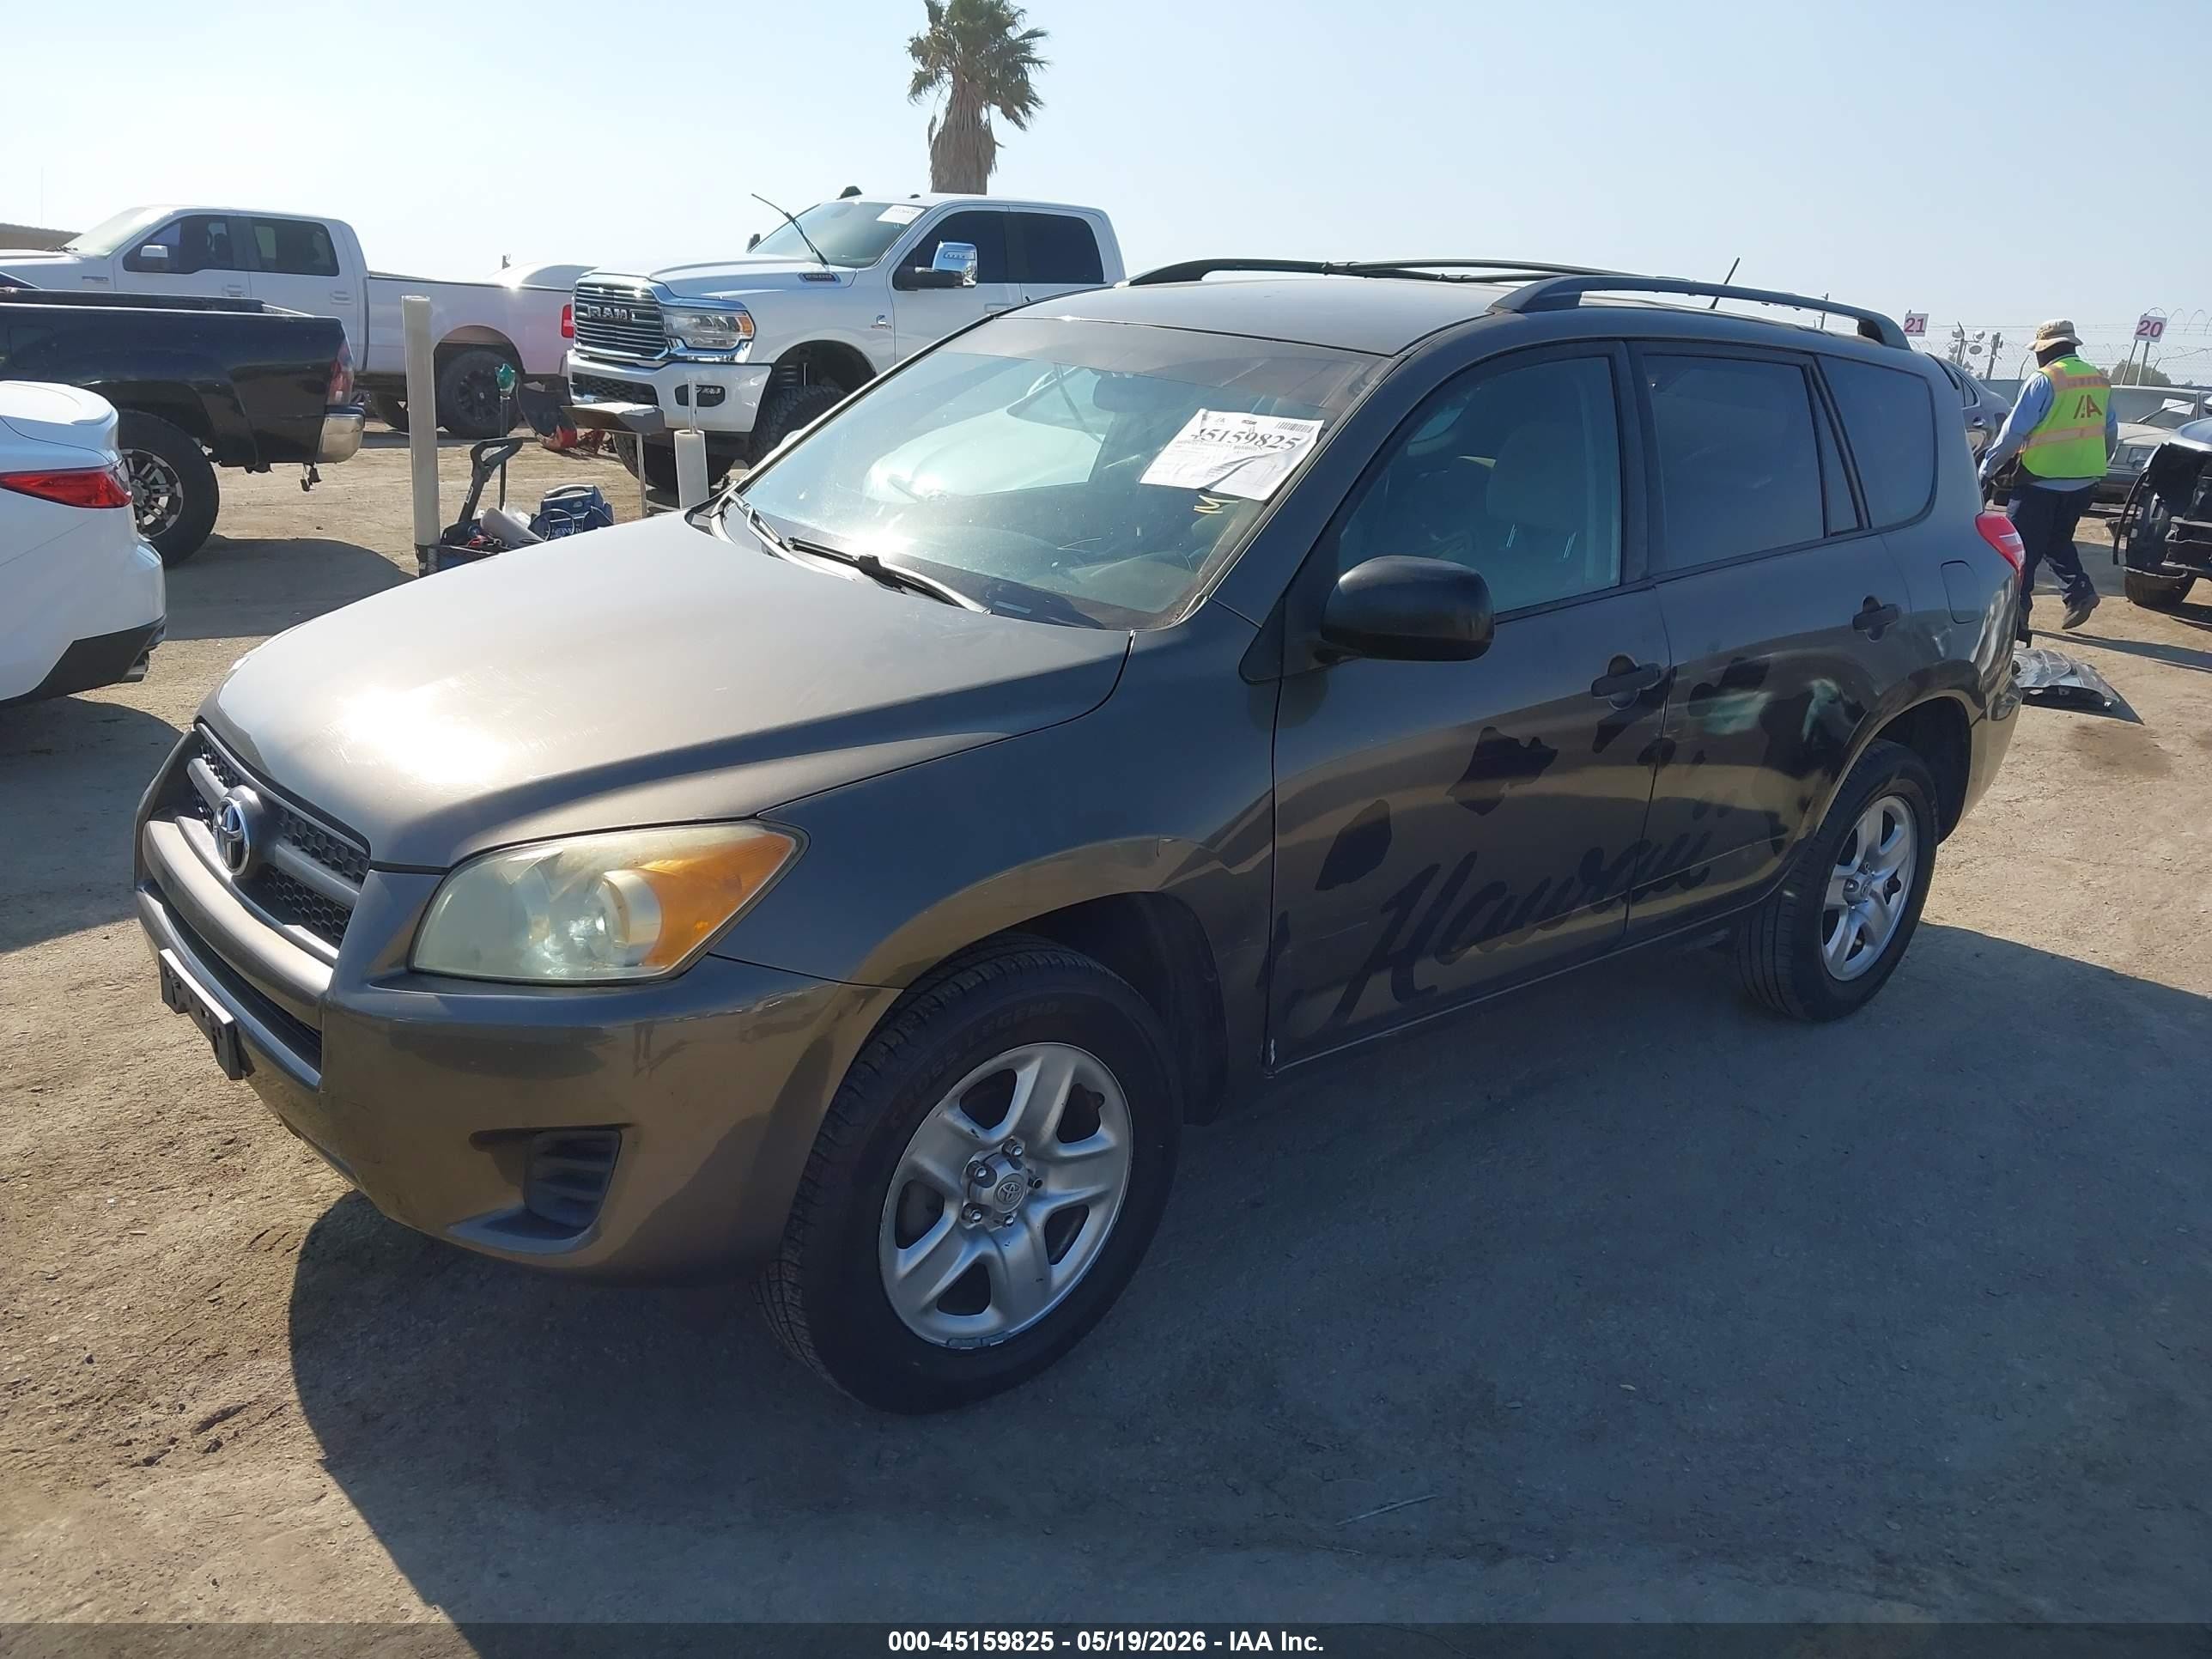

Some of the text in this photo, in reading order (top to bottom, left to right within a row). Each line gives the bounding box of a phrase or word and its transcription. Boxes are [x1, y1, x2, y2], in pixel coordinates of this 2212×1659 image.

[588, 305, 628, 321] RAM
[1904, 318, 1925, 333] 21
[2136, 319, 2164, 337] 20
